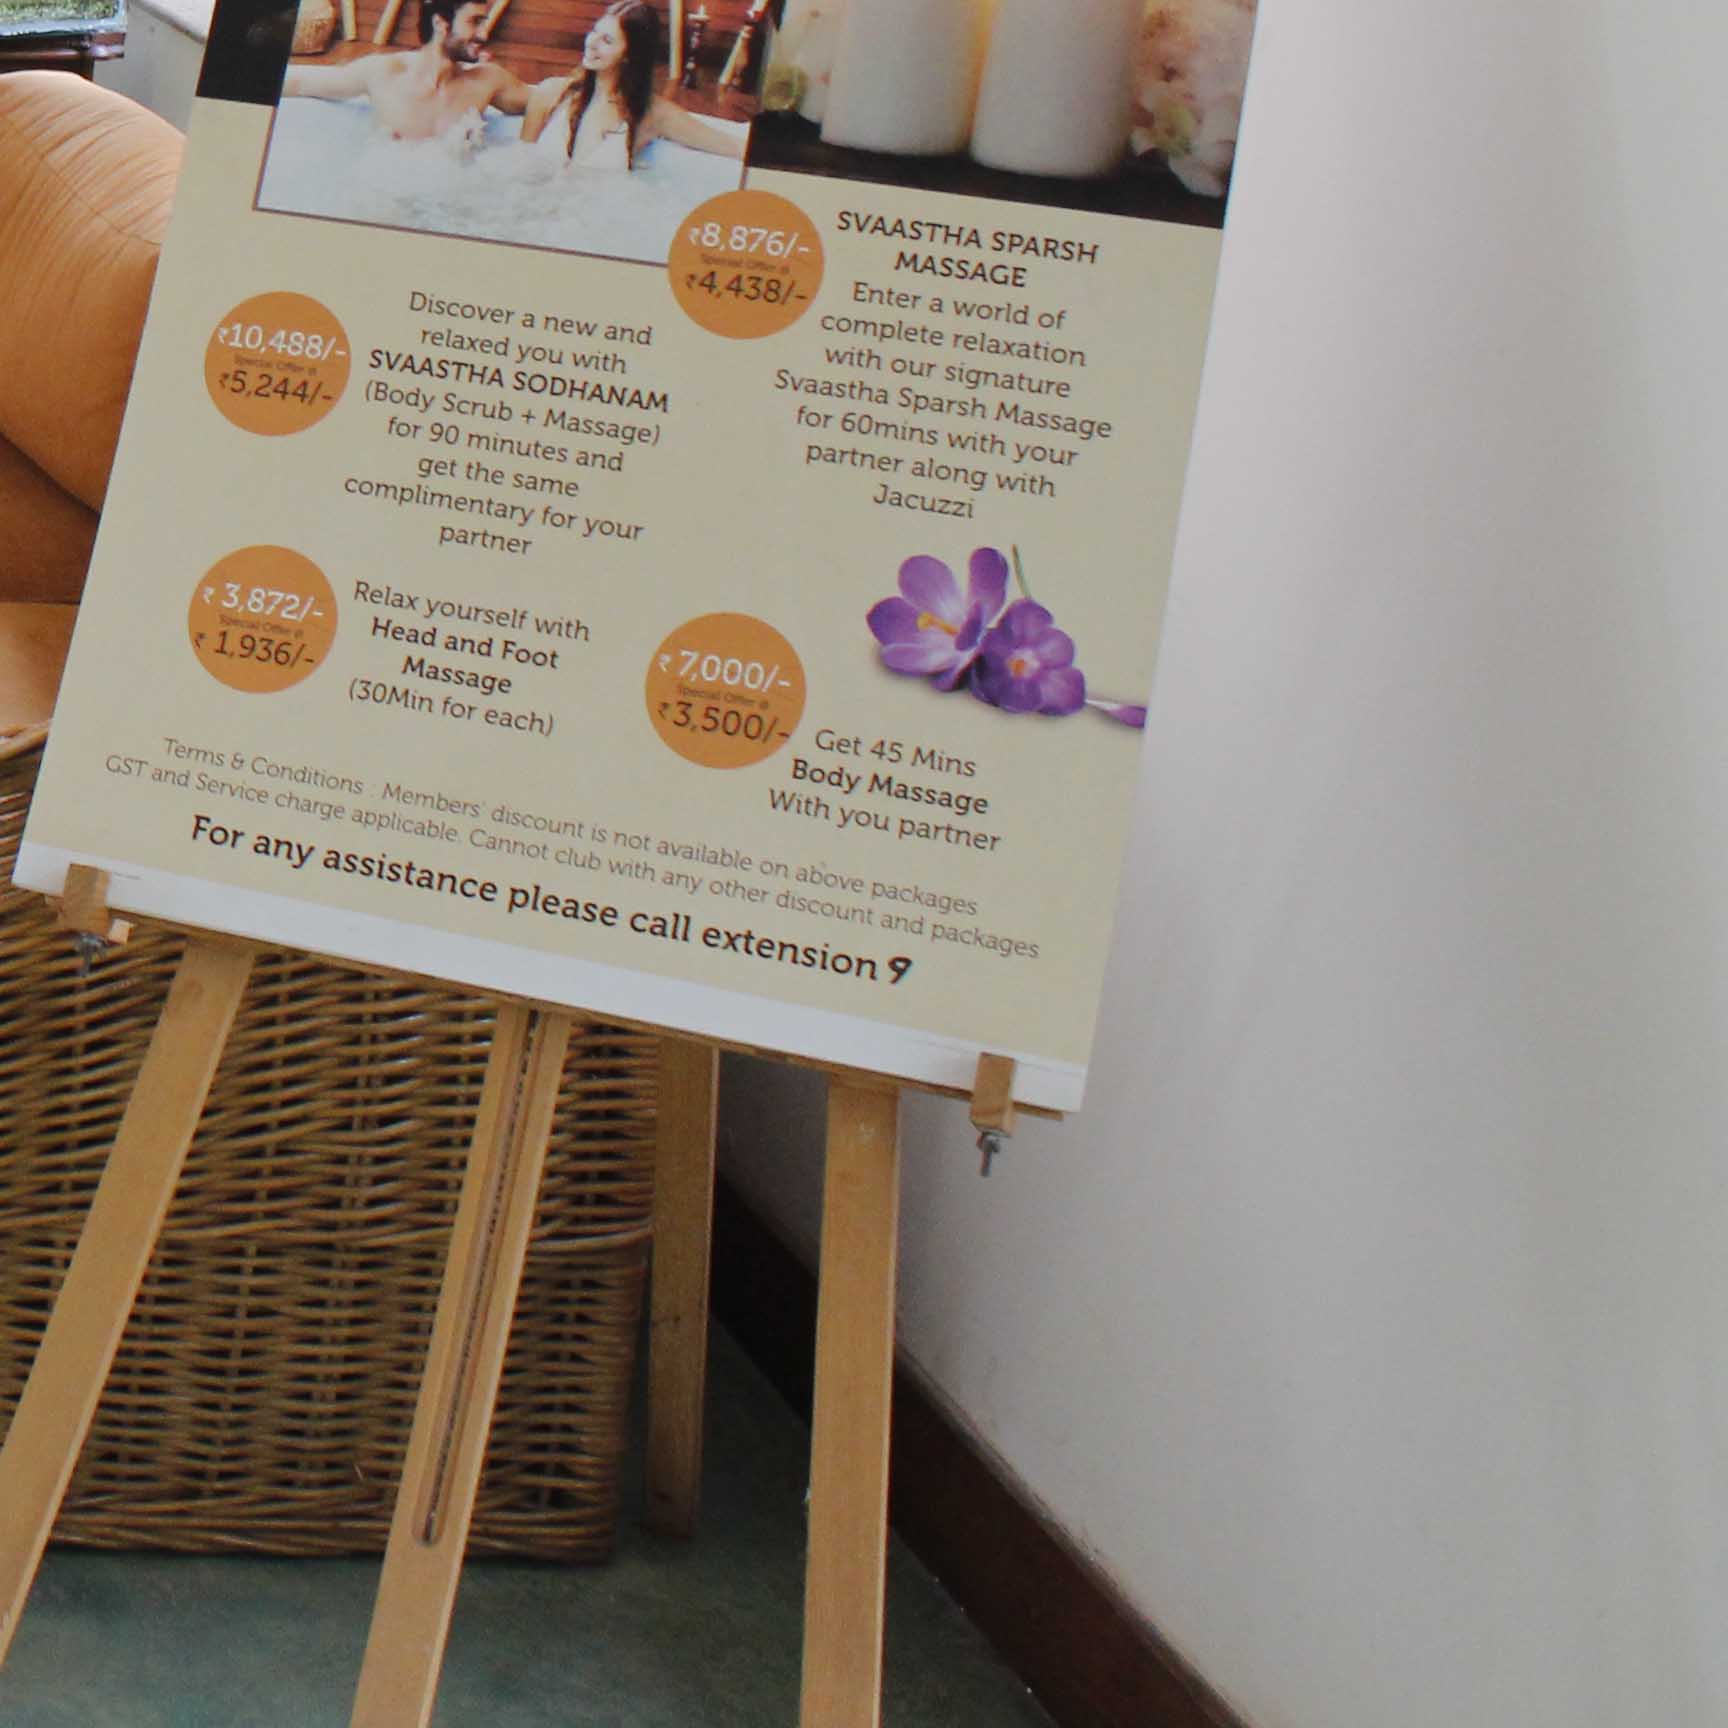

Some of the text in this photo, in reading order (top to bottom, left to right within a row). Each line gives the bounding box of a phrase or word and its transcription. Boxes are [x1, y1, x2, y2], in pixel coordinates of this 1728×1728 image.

[837, 210, 1100, 264] SVAASTHA SPARSH
[894, 251, 1027, 288] MASSAGE
[409, 291, 653, 346] Discover a new and
[853, 280, 1067, 330] Enter a world of
[421, 328, 626, 374] relaxed you with
[820, 315, 1086, 367] complete relaxation
[368, 349, 668, 413] SVAASTHA SODHANAM
[825, 347, 1071, 398] with our signature
[365, 380, 660, 446] (Body Scrub + Massage)
[774, 369, 1112, 440] Svaastha Sparsh Massage
[388, 416, 624, 472] for 90 minutes and
[797, 405, 1080, 466] for 60mins with your
[417, 458, 579, 497] get the same
[806, 445, 1056, 498] partner along with
[344, 478, 645, 540] complimentary for your
[872, 483, 975, 519] Jacuzzi
[438, 526, 532, 555] partner
[354, 580, 589, 642] Relax yourself with
[372, 616, 559, 670] Head and Foot
[401, 655, 512, 696] Massage
[349, 678, 554, 737] (30Min for each)
[815, 729, 976, 778] Get 45 Mins
[792, 758, 989, 816] Body Massage
[164, 737, 225, 767] Terms
[251, 756, 364, 795] Conditions
[491, 805, 584, 839] discount
[591, 824, 608, 843] is
[614, 832, 651, 852] not
[656, 840, 752, 872] available
[760, 860, 788, 880] on
[795, 862, 864, 893] above
[871, 882, 977, 915] packages
[769, 788, 1002, 851] With you partner
[106, 755, 149, 776] GST
[152, 768, 191, 788] and
[195, 772, 269, 804] Service
[274, 792, 346, 822] charge
[469, 828, 549, 861] Cannot
[554, 848, 602, 872] club
[608, 858, 655, 883] with
[661, 871, 703, 895] any
[709, 880, 771, 904] other
[776, 889, 874, 926] discount
[880, 914, 924, 936] and
[930, 924, 1039, 958] packages
[192, 814, 246, 850] For
[252, 835, 316, 870] any
[322, 848, 498, 902] assistance
[507, 883, 619, 928] please
[629, 912, 692, 944] call
[701, 926, 878, 982] extension
